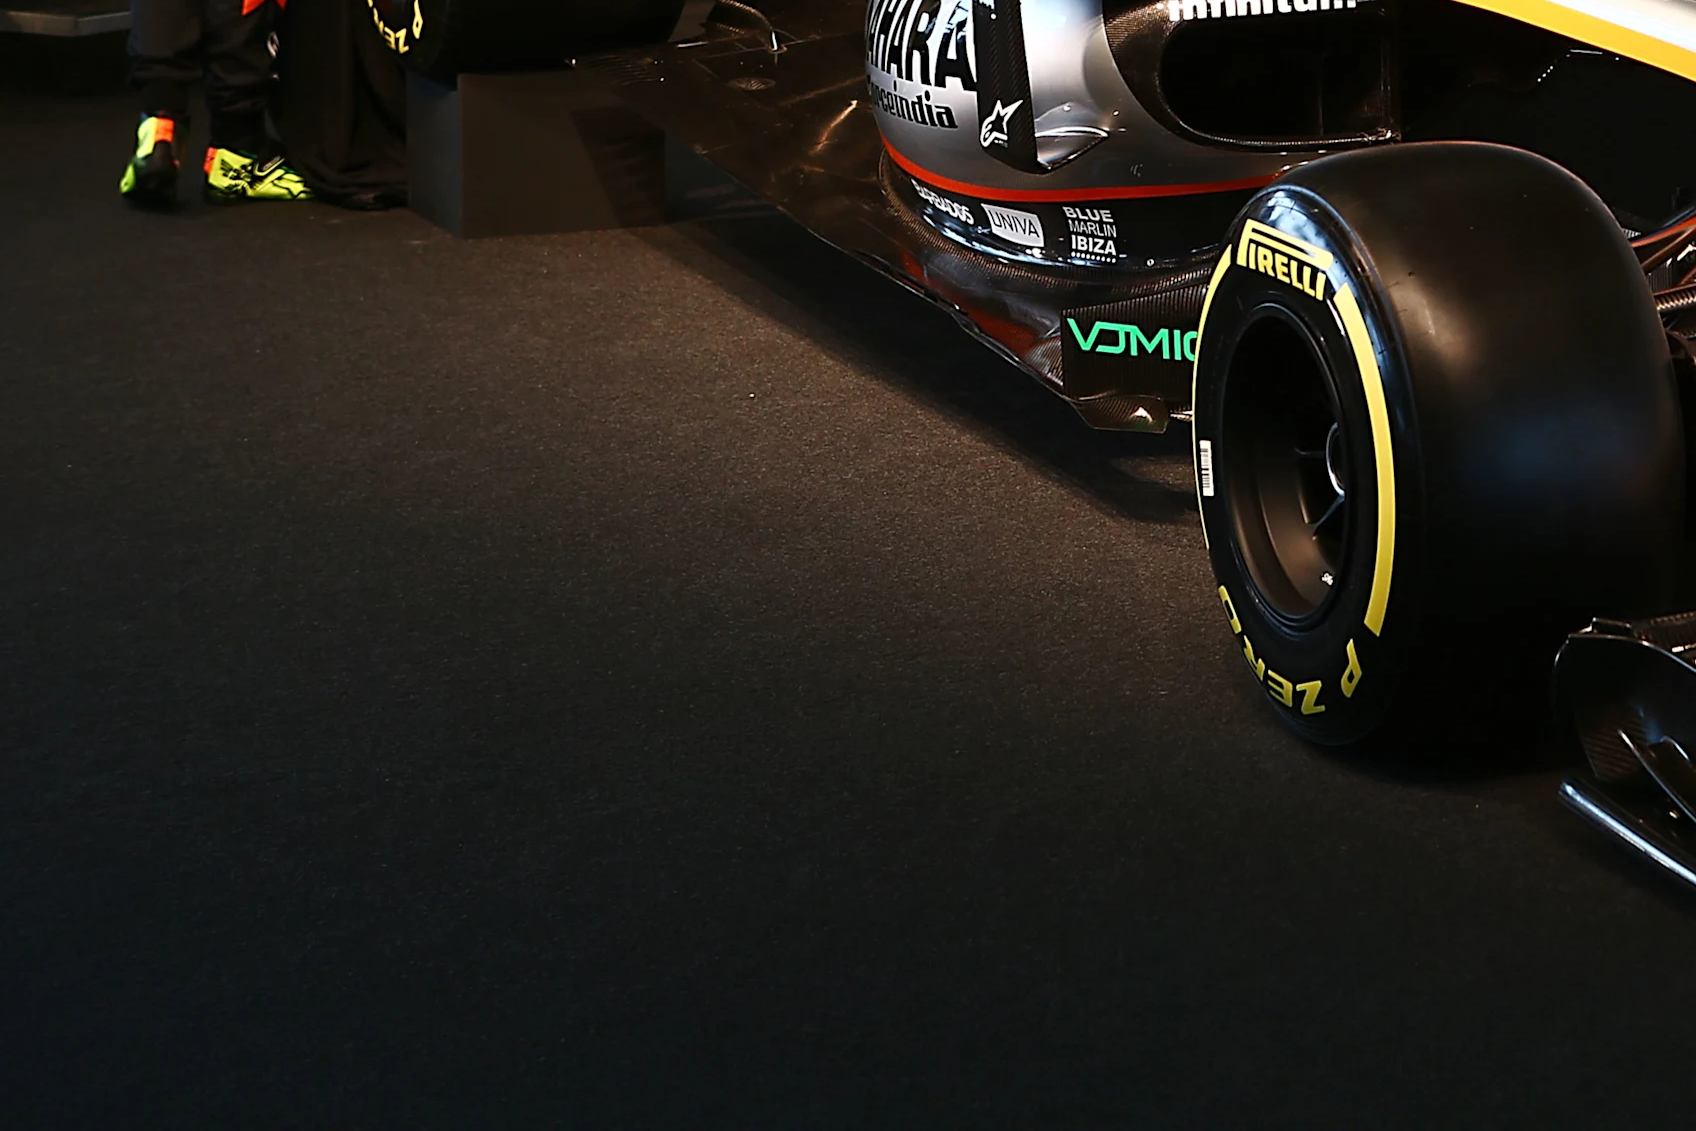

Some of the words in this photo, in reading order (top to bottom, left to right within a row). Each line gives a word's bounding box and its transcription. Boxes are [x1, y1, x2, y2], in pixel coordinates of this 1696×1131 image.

[988, 208, 1041, 238] UNIVA
[1062, 206, 1115, 223] BLUE
[1068, 219, 1117, 238] MARLIN
[1071, 234, 1117, 256] IBIZA
[1236, 218, 1335, 301] PIRELLI
